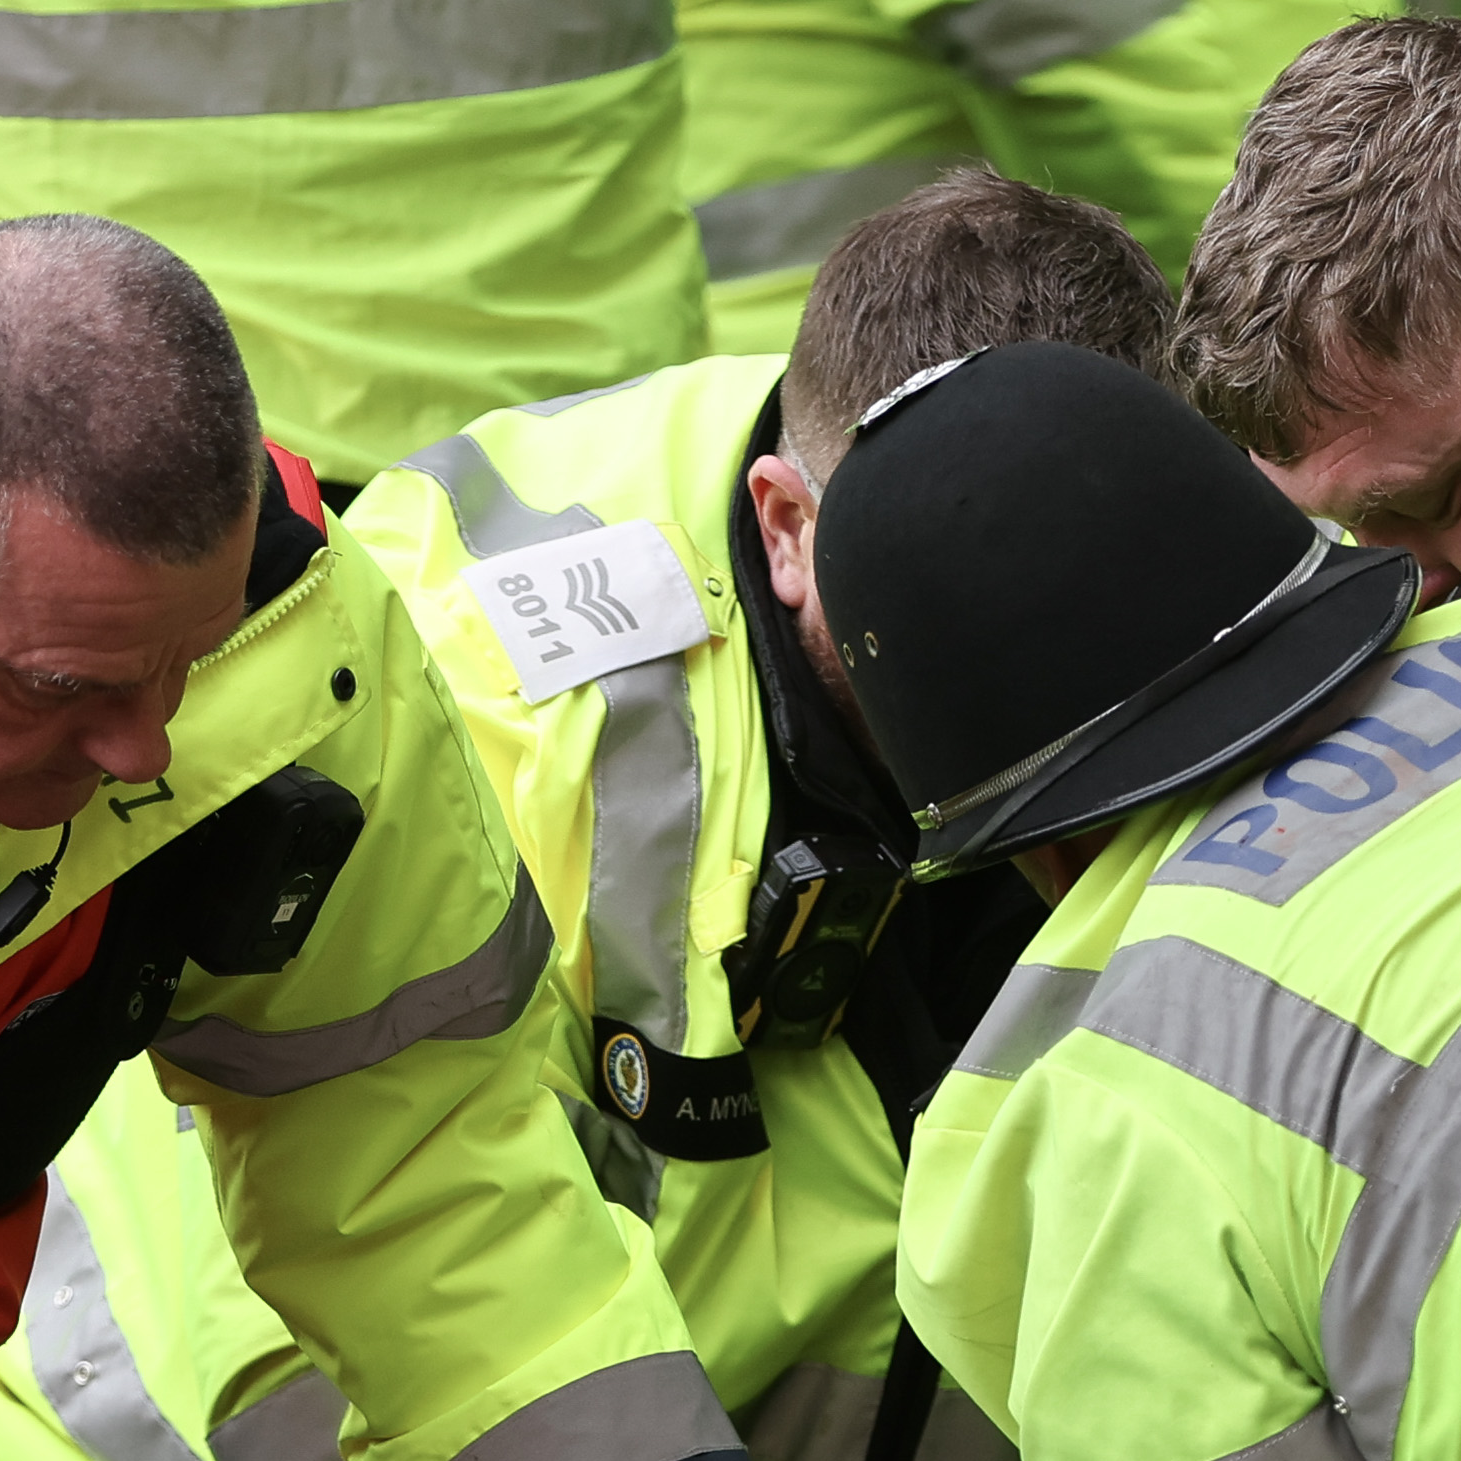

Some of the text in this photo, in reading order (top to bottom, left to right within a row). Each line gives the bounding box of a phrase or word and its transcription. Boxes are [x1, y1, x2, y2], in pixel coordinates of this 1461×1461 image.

[497, 573, 575, 663] 8011
[675, 1092, 760, 1121] A. MYN
